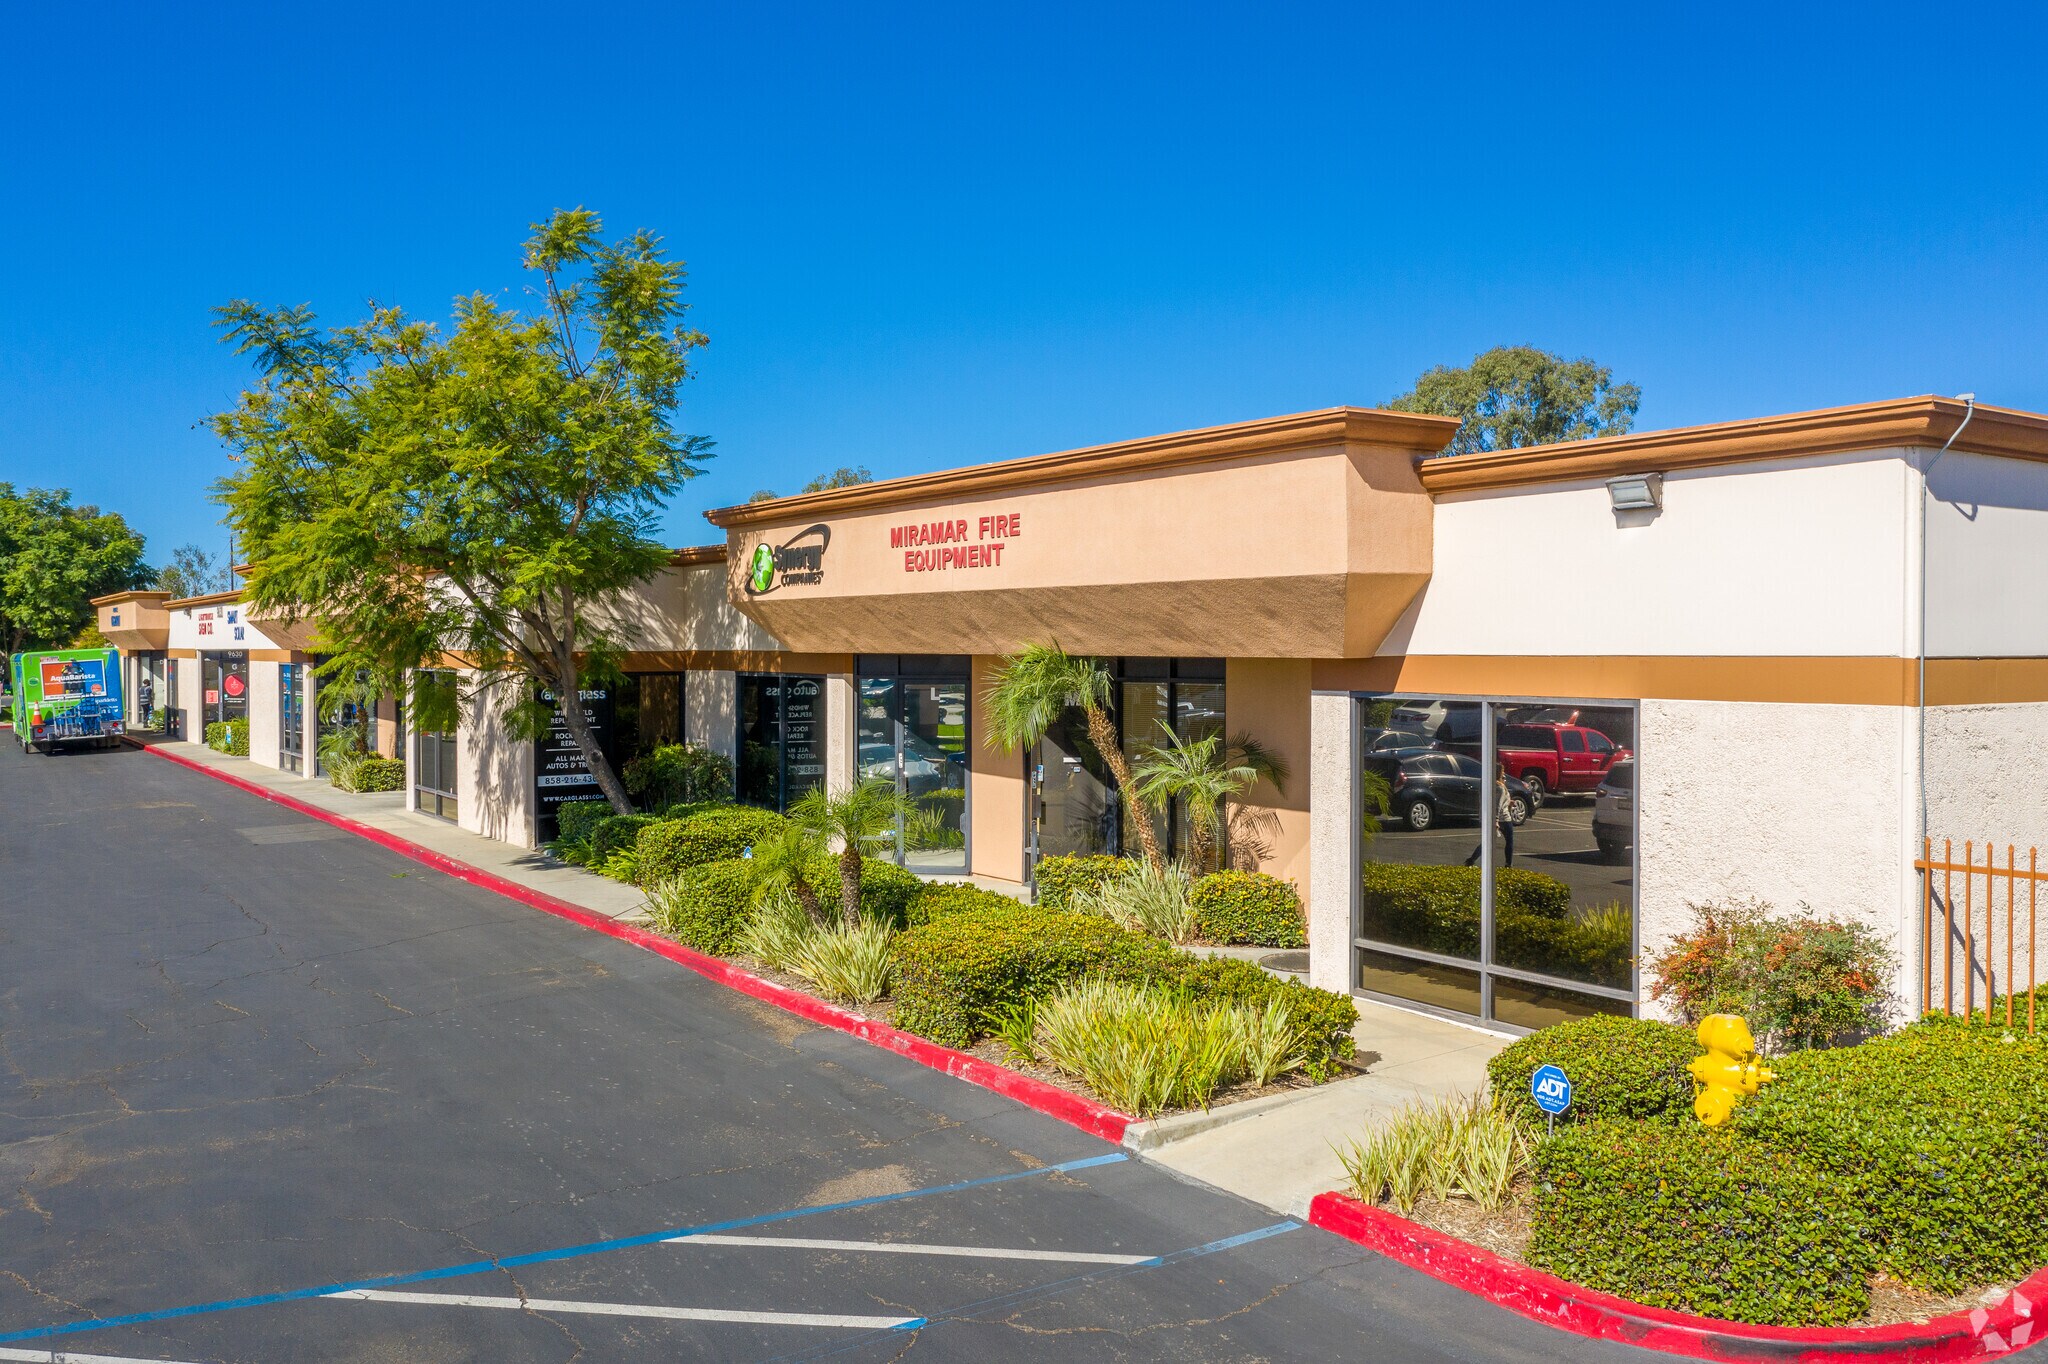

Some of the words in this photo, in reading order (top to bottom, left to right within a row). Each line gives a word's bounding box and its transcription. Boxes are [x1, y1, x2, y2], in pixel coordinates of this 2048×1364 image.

[890, 519, 968, 548] MIRAMAR
[978, 512, 1021, 541] FIRE
[773, 545, 823, 574] Synergy
[904, 543, 1005, 573] EQUIPMENT
[227, 650, 243, 658] 9630
[50, 673, 96, 684] AquaBarista
[930, 687, 941, 700] L
[555, 732, 574, 740] ROCK
[545, 762, 569, 770] AUTOS
[544, 775, 597, 785] 858-216-43
[1536, 1077, 1568, 1099] ADT
